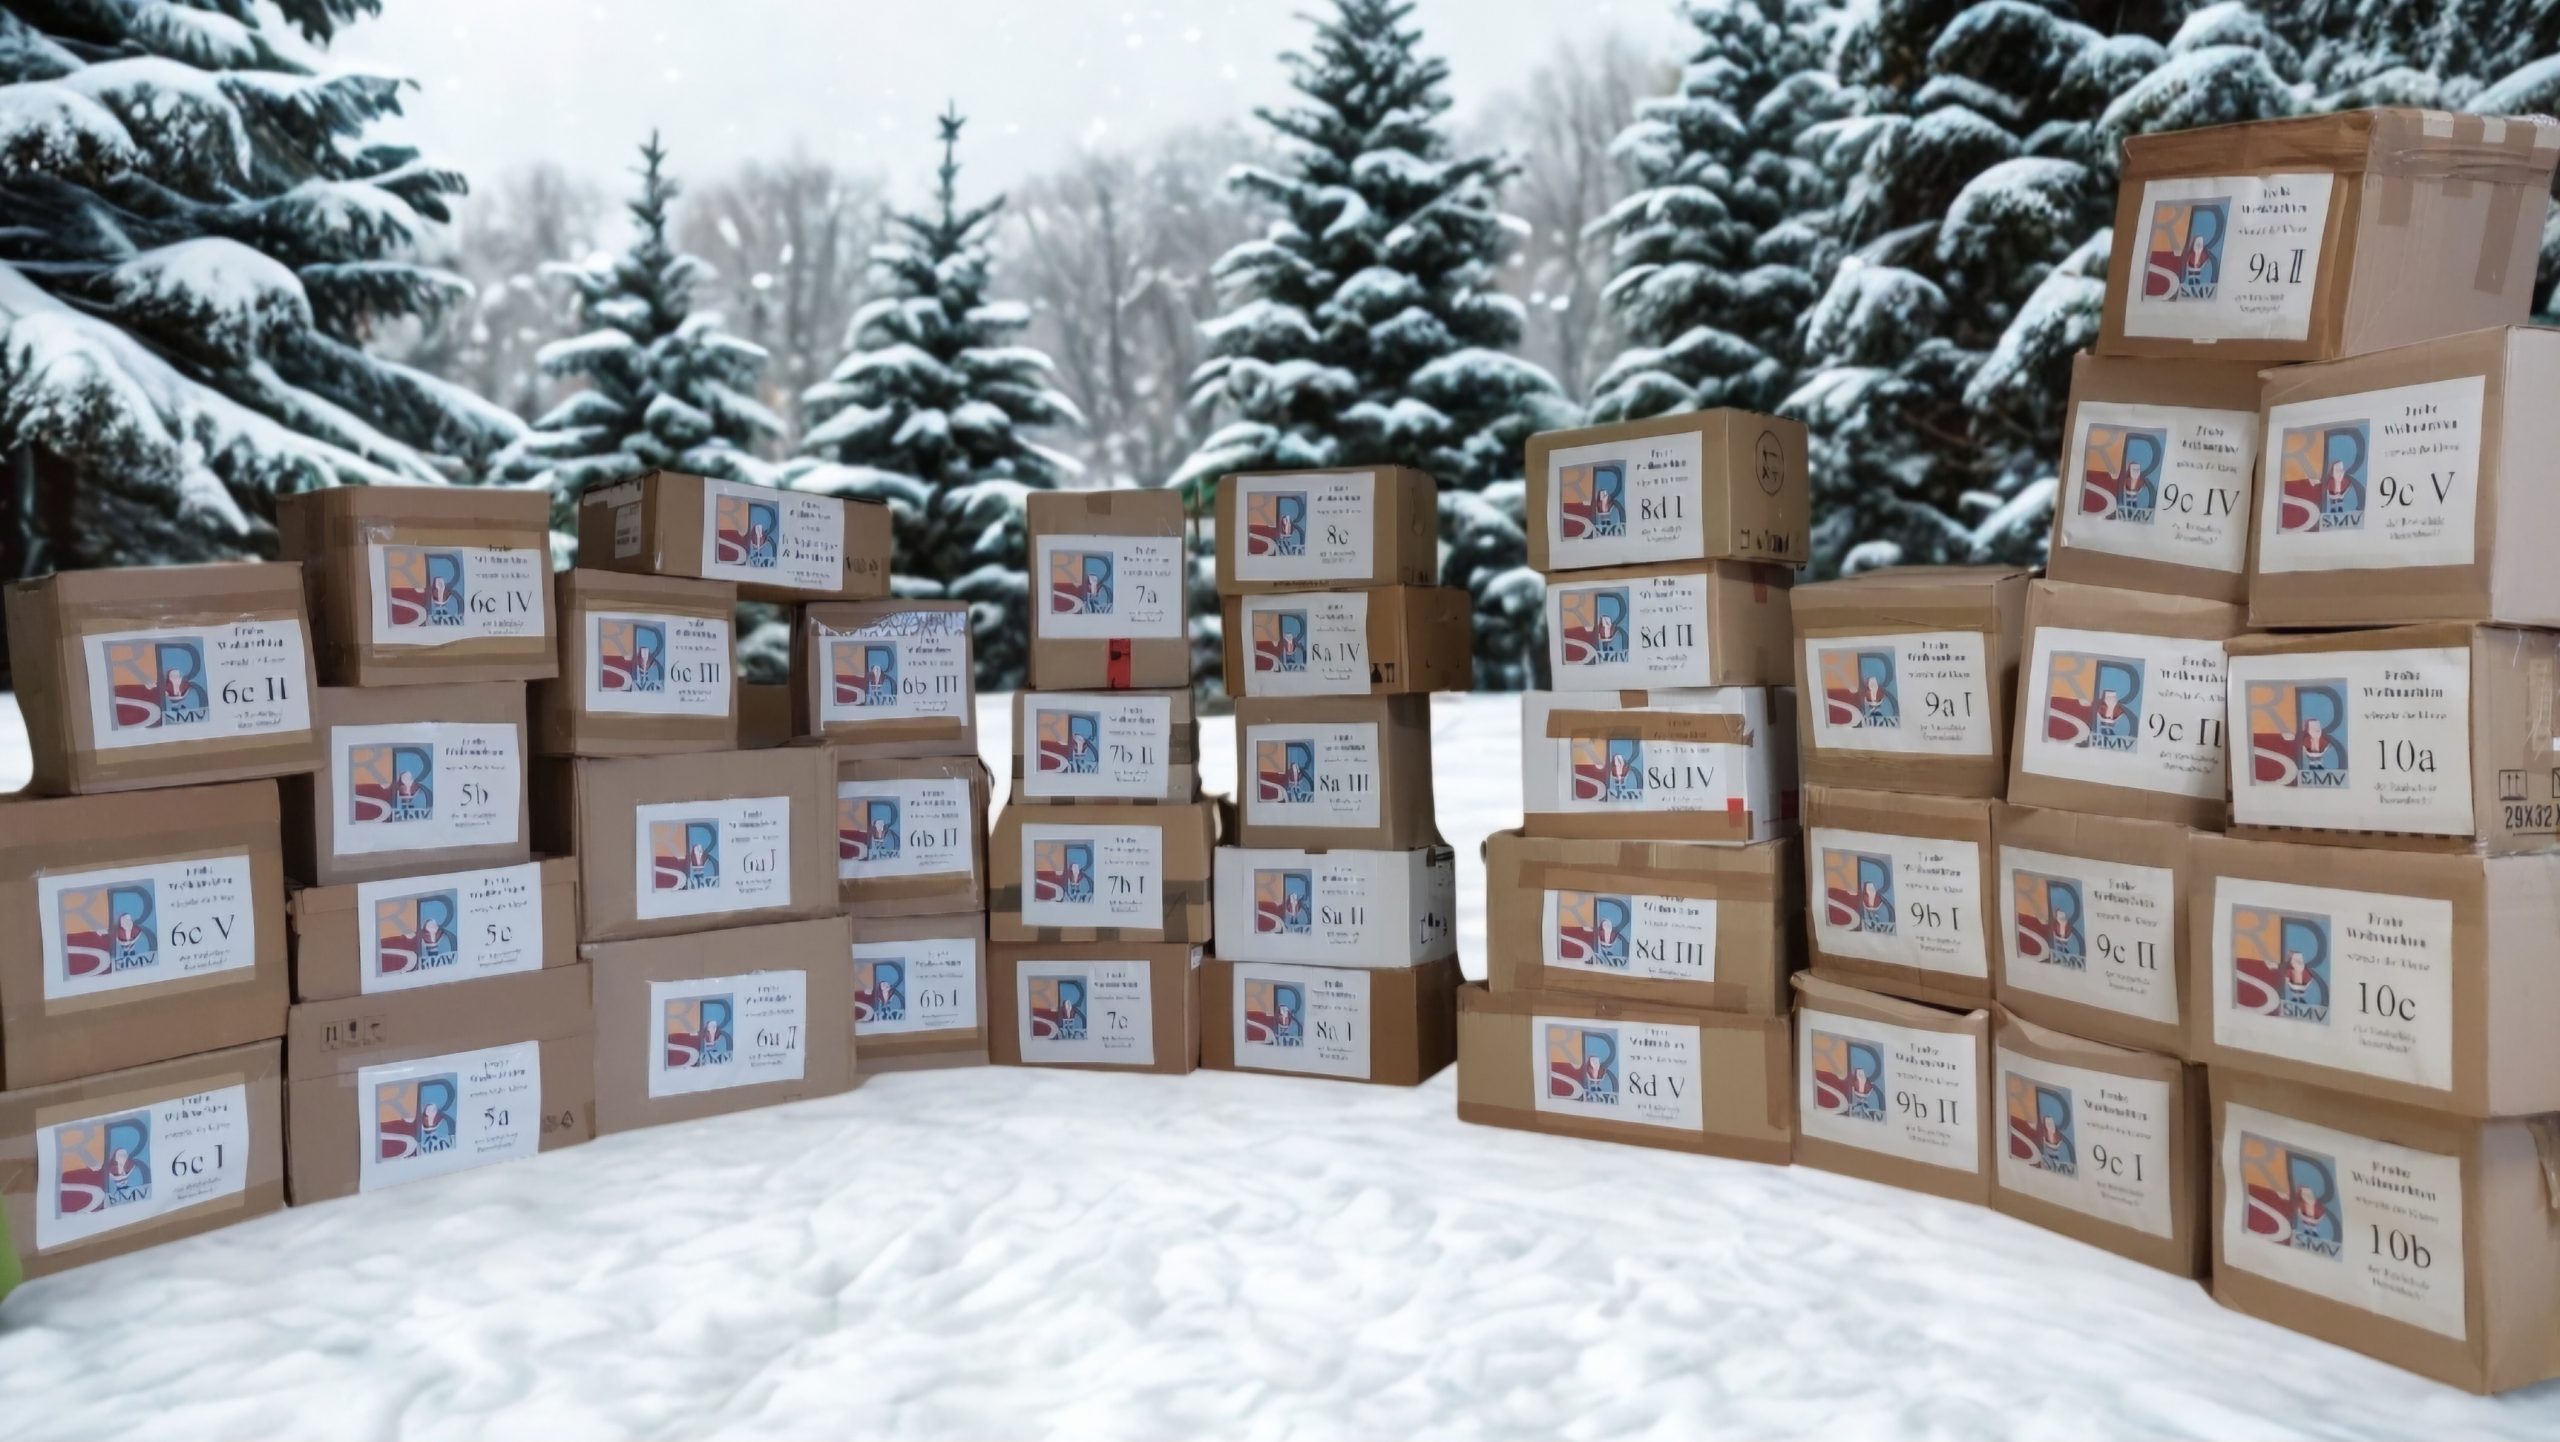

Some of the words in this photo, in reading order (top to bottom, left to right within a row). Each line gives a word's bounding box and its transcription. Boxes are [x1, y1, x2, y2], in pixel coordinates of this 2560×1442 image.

[2248, 253, 2280, 284] 9a
[2288, 248, 2305, 284] II
[2161, 483, 2194, 514] 9c
[2203, 488, 2244, 520] IV
[2379, 476, 2414, 509] 9c
[2430, 471, 2456, 505] V
[1641, 495, 1667, 521] 8d
[2320, 513, 2363, 529] SMV
[1326, 524, 1349, 546] 8c
[507, 591, 533, 614] IV
[1135, 585, 1158, 604] 7a
[1640, 624, 1667, 649] 8d
[1676, 623, 1694, 647] II
[1339, 642, 1361, 663] IV
[670, 663, 692, 683] 6c
[699, 662, 720, 684] III
[935, 674, 958, 694] III
[222, 679, 255, 705] 6c
[264, 676, 288, 702] II
[1925, 691, 1955, 718] 9a
[2148, 713, 2184, 742] 9c
[2377, 739, 2437, 773] 10a
[1348, 773, 1369, 792] III
[1647, 766, 1676, 790] 8d
[1685, 766, 1714, 789] IV
[2301, 768, 2346, 787] SMV
[171, 921, 203, 947] 6c
[211, 914, 235, 940] V
[1675, 941, 1703, 967] III
[2096, 933, 2126, 964] 9c
[2137, 940, 2158, 971] II
[2281, 1002, 2328, 1022] SMV
[2358, 982, 2416, 1022] 10c
[1628, 1071, 1657, 1097] 8d
[1667, 1076, 1685, 1099] V
[1896, 1090, 1928, 1119] 9b
[1938, 1098, 1959, 1126] II
[171, 1151, 204, 1177] 6c
[2092, 1144, 2123, 1177] 9c
[2135, 1153, 2143, 1182] I
[2294, 1231, 2341, 1257] SMV
[2368, 1223, 2432, 1274] 10b
